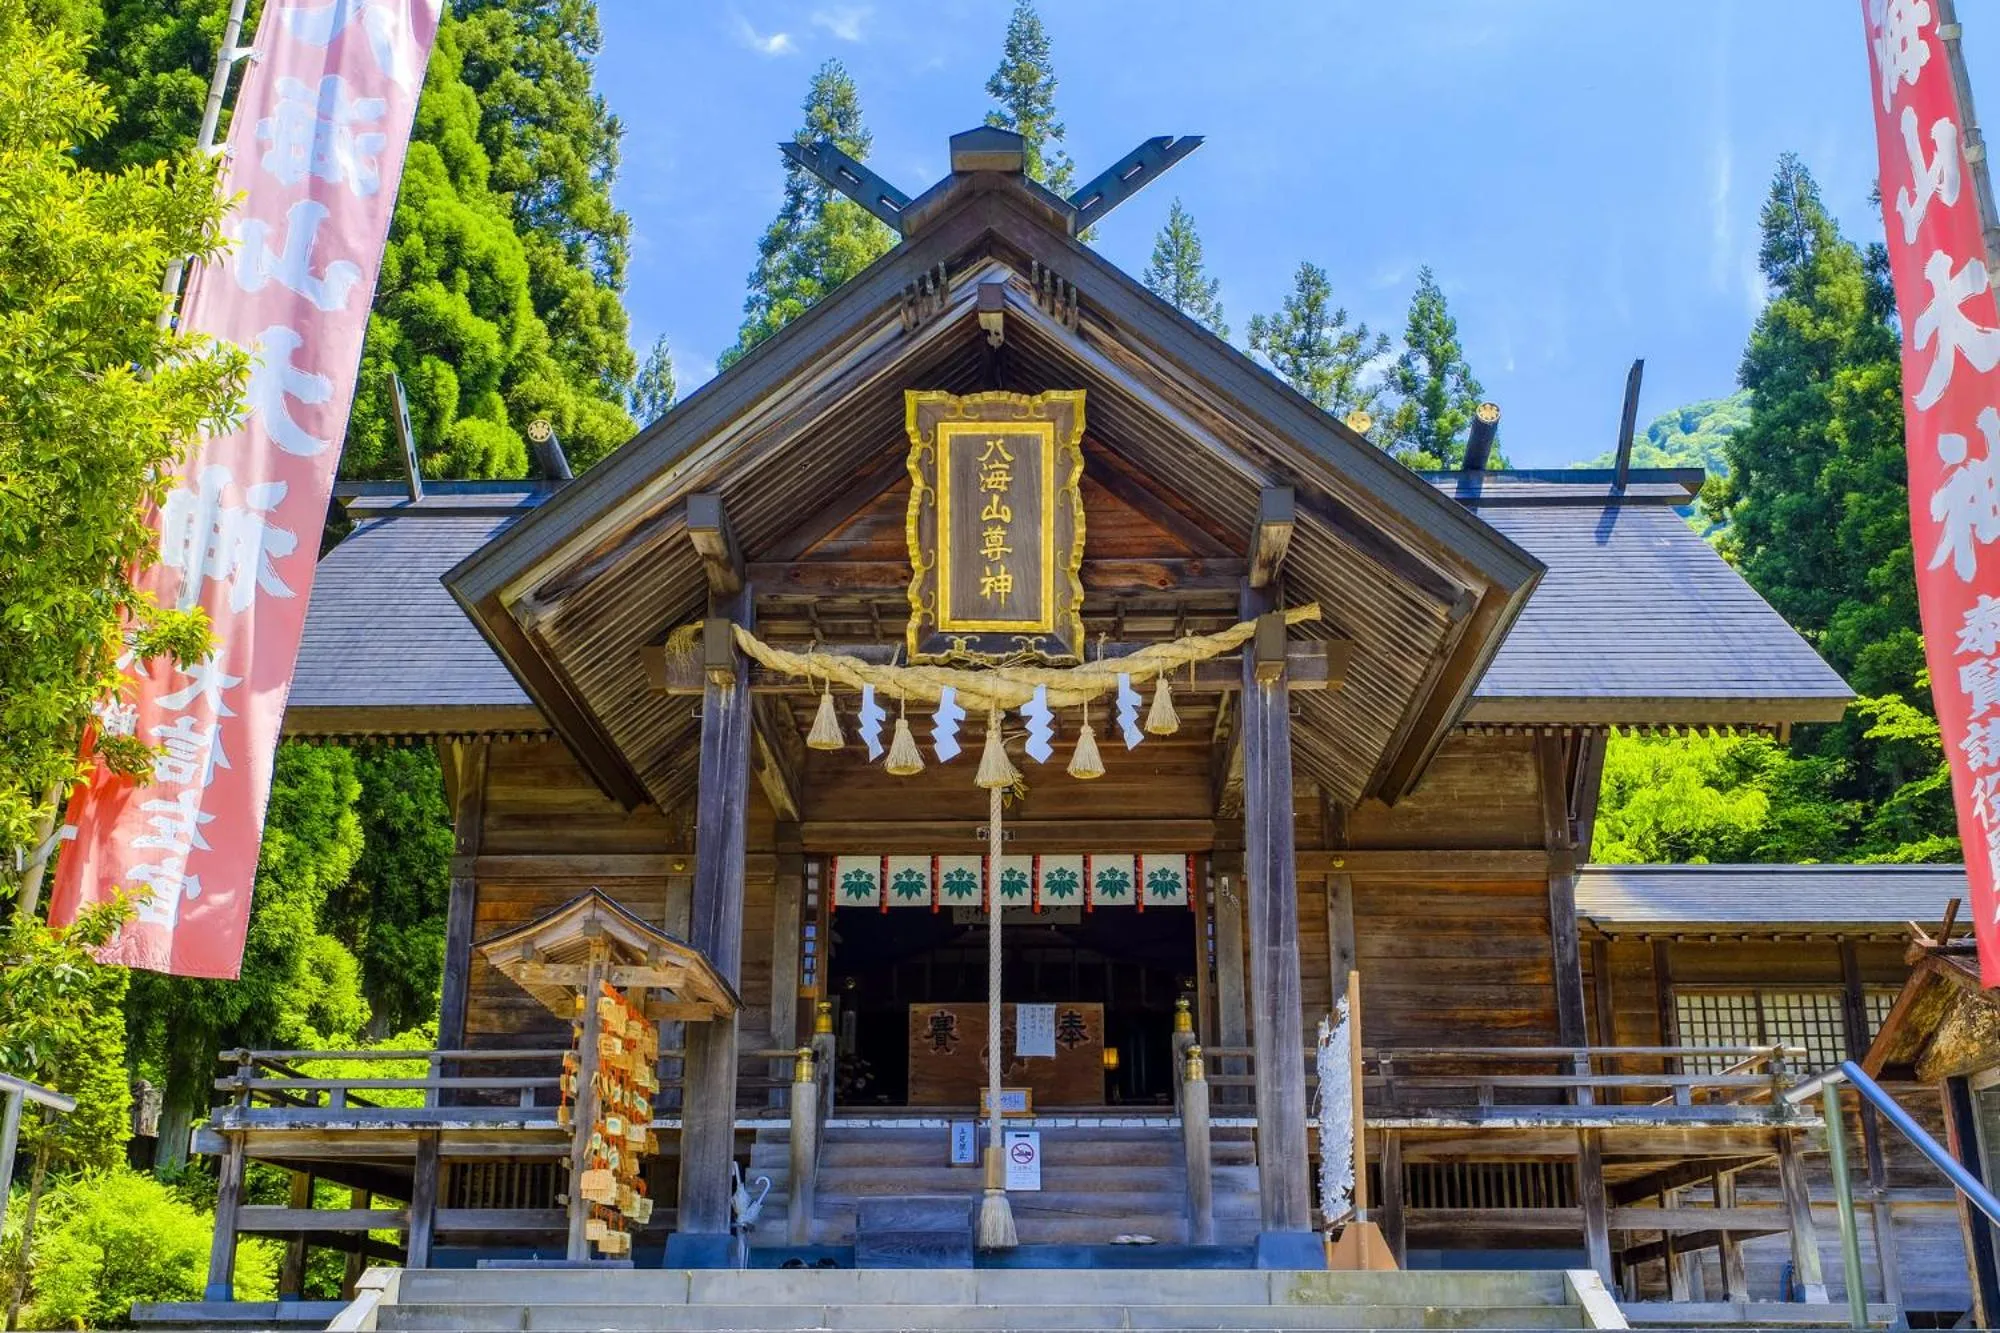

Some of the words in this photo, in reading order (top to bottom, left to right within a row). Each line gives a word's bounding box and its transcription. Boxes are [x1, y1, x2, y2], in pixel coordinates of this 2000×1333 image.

[976, 439, 1014, 608] 八海山尊神
[1056, 1010, 1090, 1049] 奉
